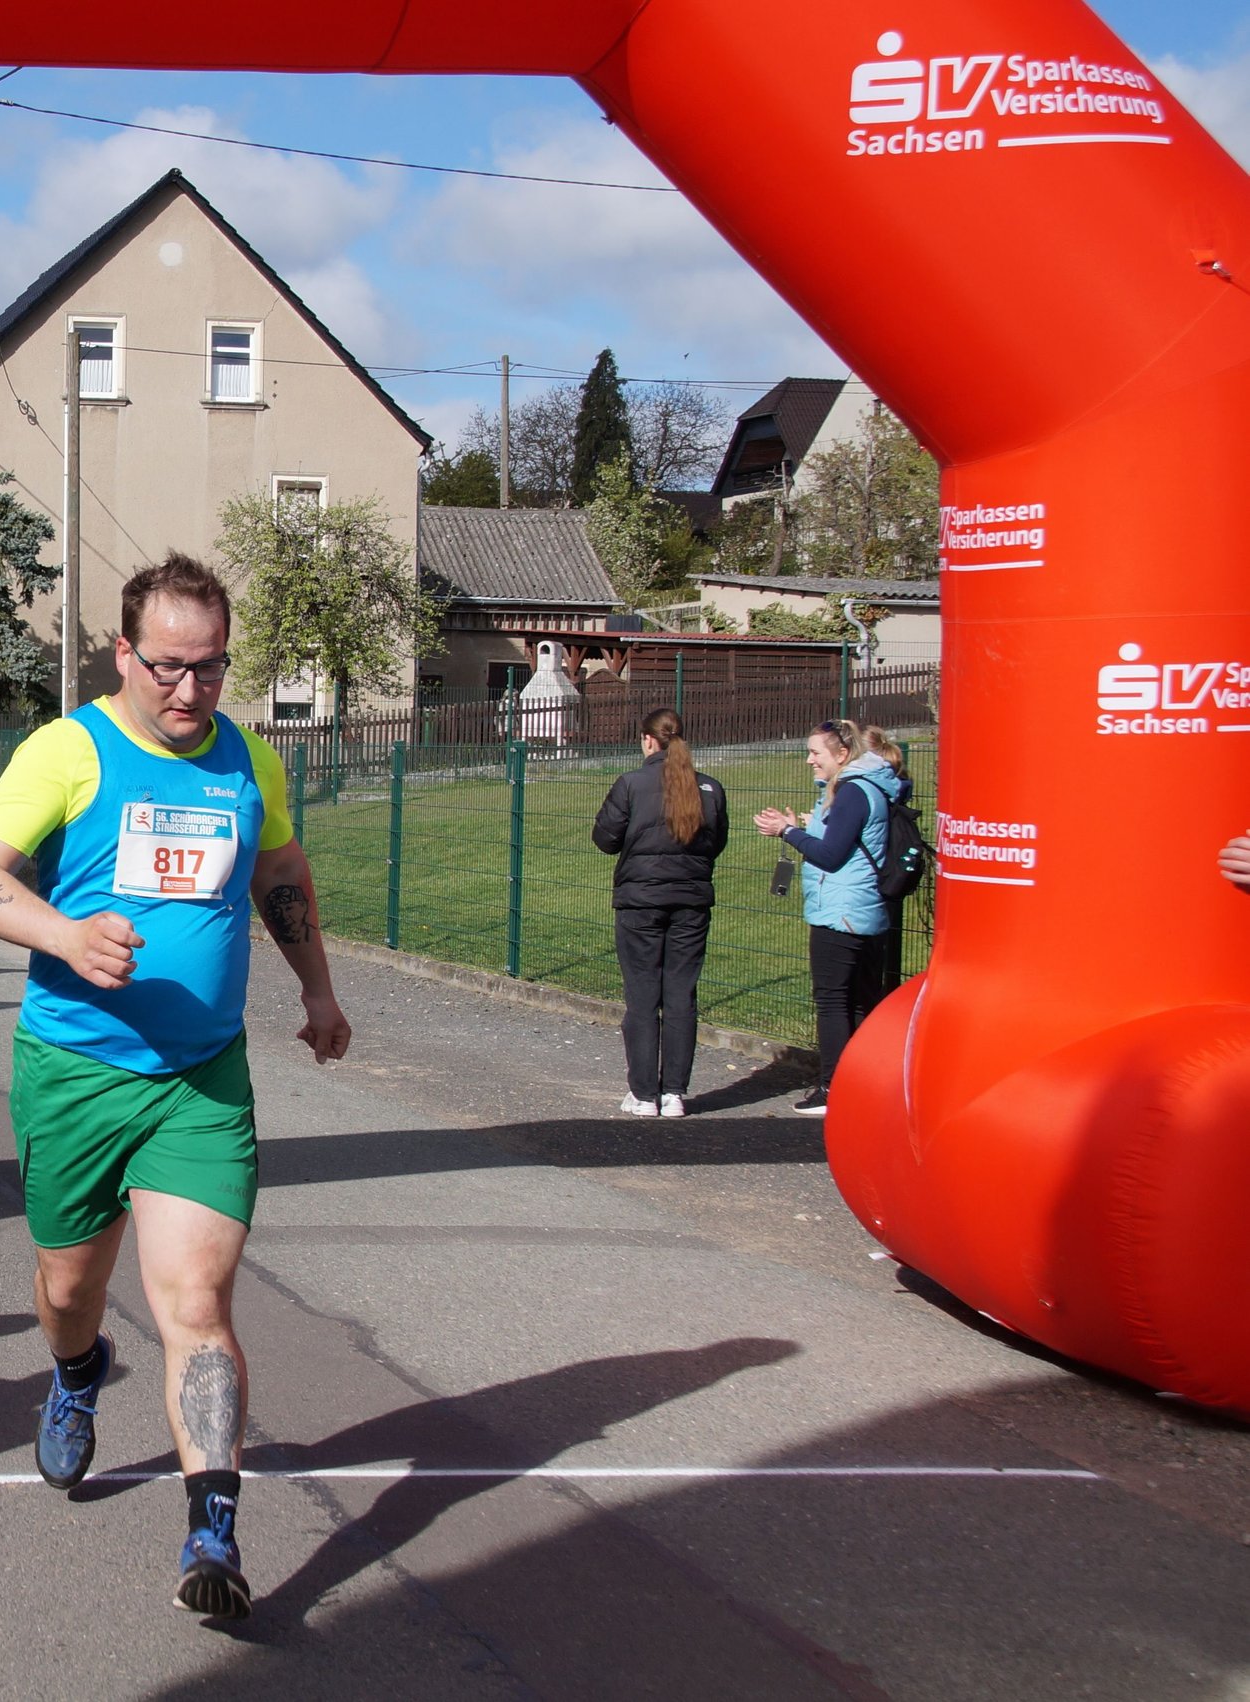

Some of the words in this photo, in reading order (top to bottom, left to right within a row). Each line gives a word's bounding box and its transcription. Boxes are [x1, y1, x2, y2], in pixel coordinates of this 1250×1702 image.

[1006, 55, 1151, 91] Sparkassen
[990, 87, 1163, 124] Versicherung
[846, 127, 984, 156] Sachsen
[950, 503, 1045, 530] Sparkassen
[947, 528, 1045, 550] Versicherung
[1096, 713, 1208, 734] Sachsen
[155, 811, 168, 822] 56.
[155, 821, 217, 835] STRASSENLAUF
[945, 814, 1037, 839] Sparkassen
[153, 847, 205, 875] 817
[942, 836, 1036, 869] Versicherung
